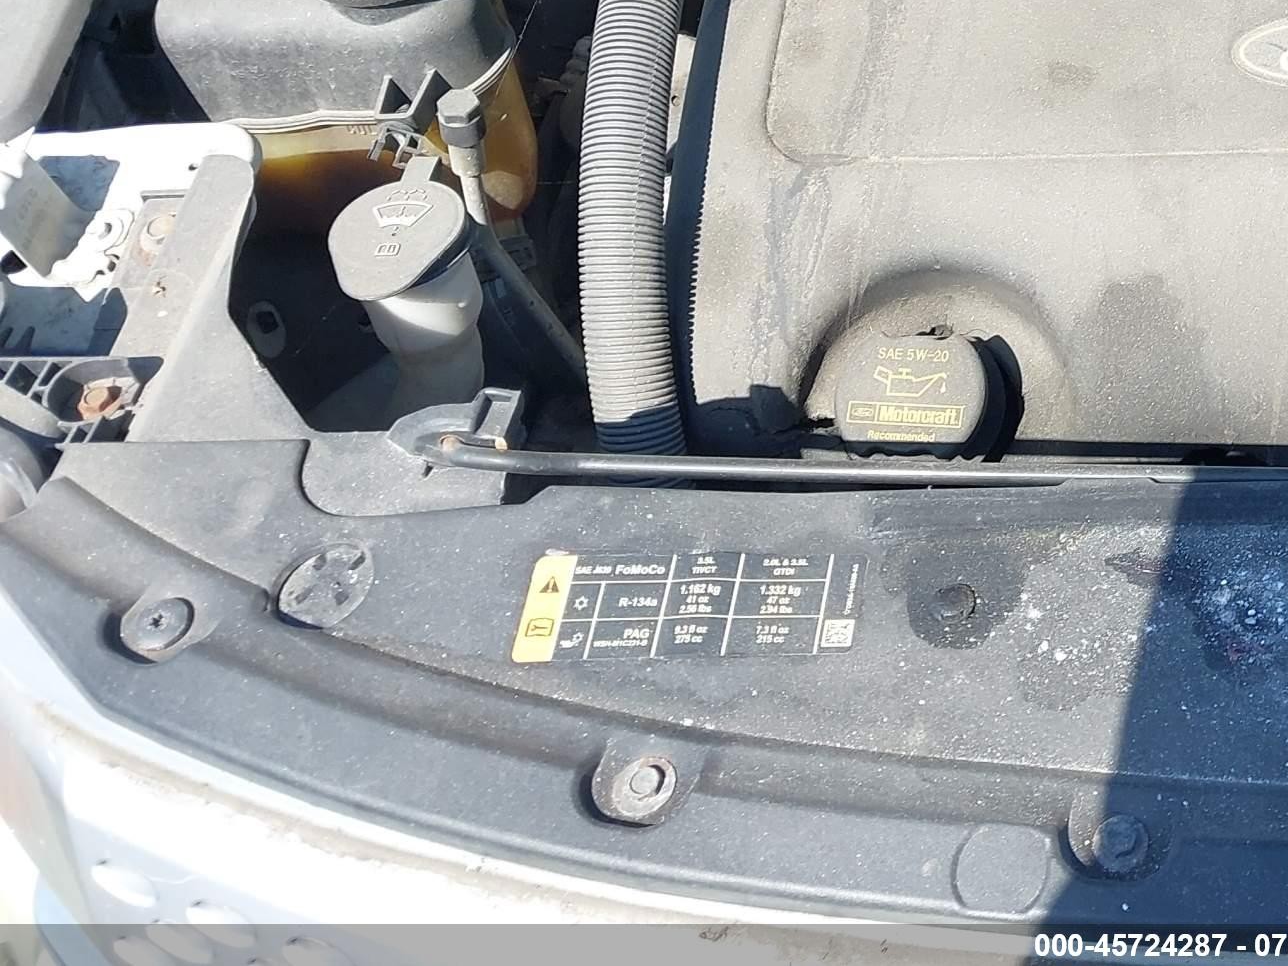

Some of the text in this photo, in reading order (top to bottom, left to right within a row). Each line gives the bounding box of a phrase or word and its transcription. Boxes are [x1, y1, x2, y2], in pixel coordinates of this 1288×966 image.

[878, 347, 949, 362] SAE 5W-20
[879, 405, 958, 425] Motorcraft
[615, 564, 666, 575] FoMoCo
[707, 583, 721, 596] kg
[760, 584, 802, 597] 1.332 kg
[618, 597, 658, 607] R-134a
[623, 628, 650, 639] PAG
